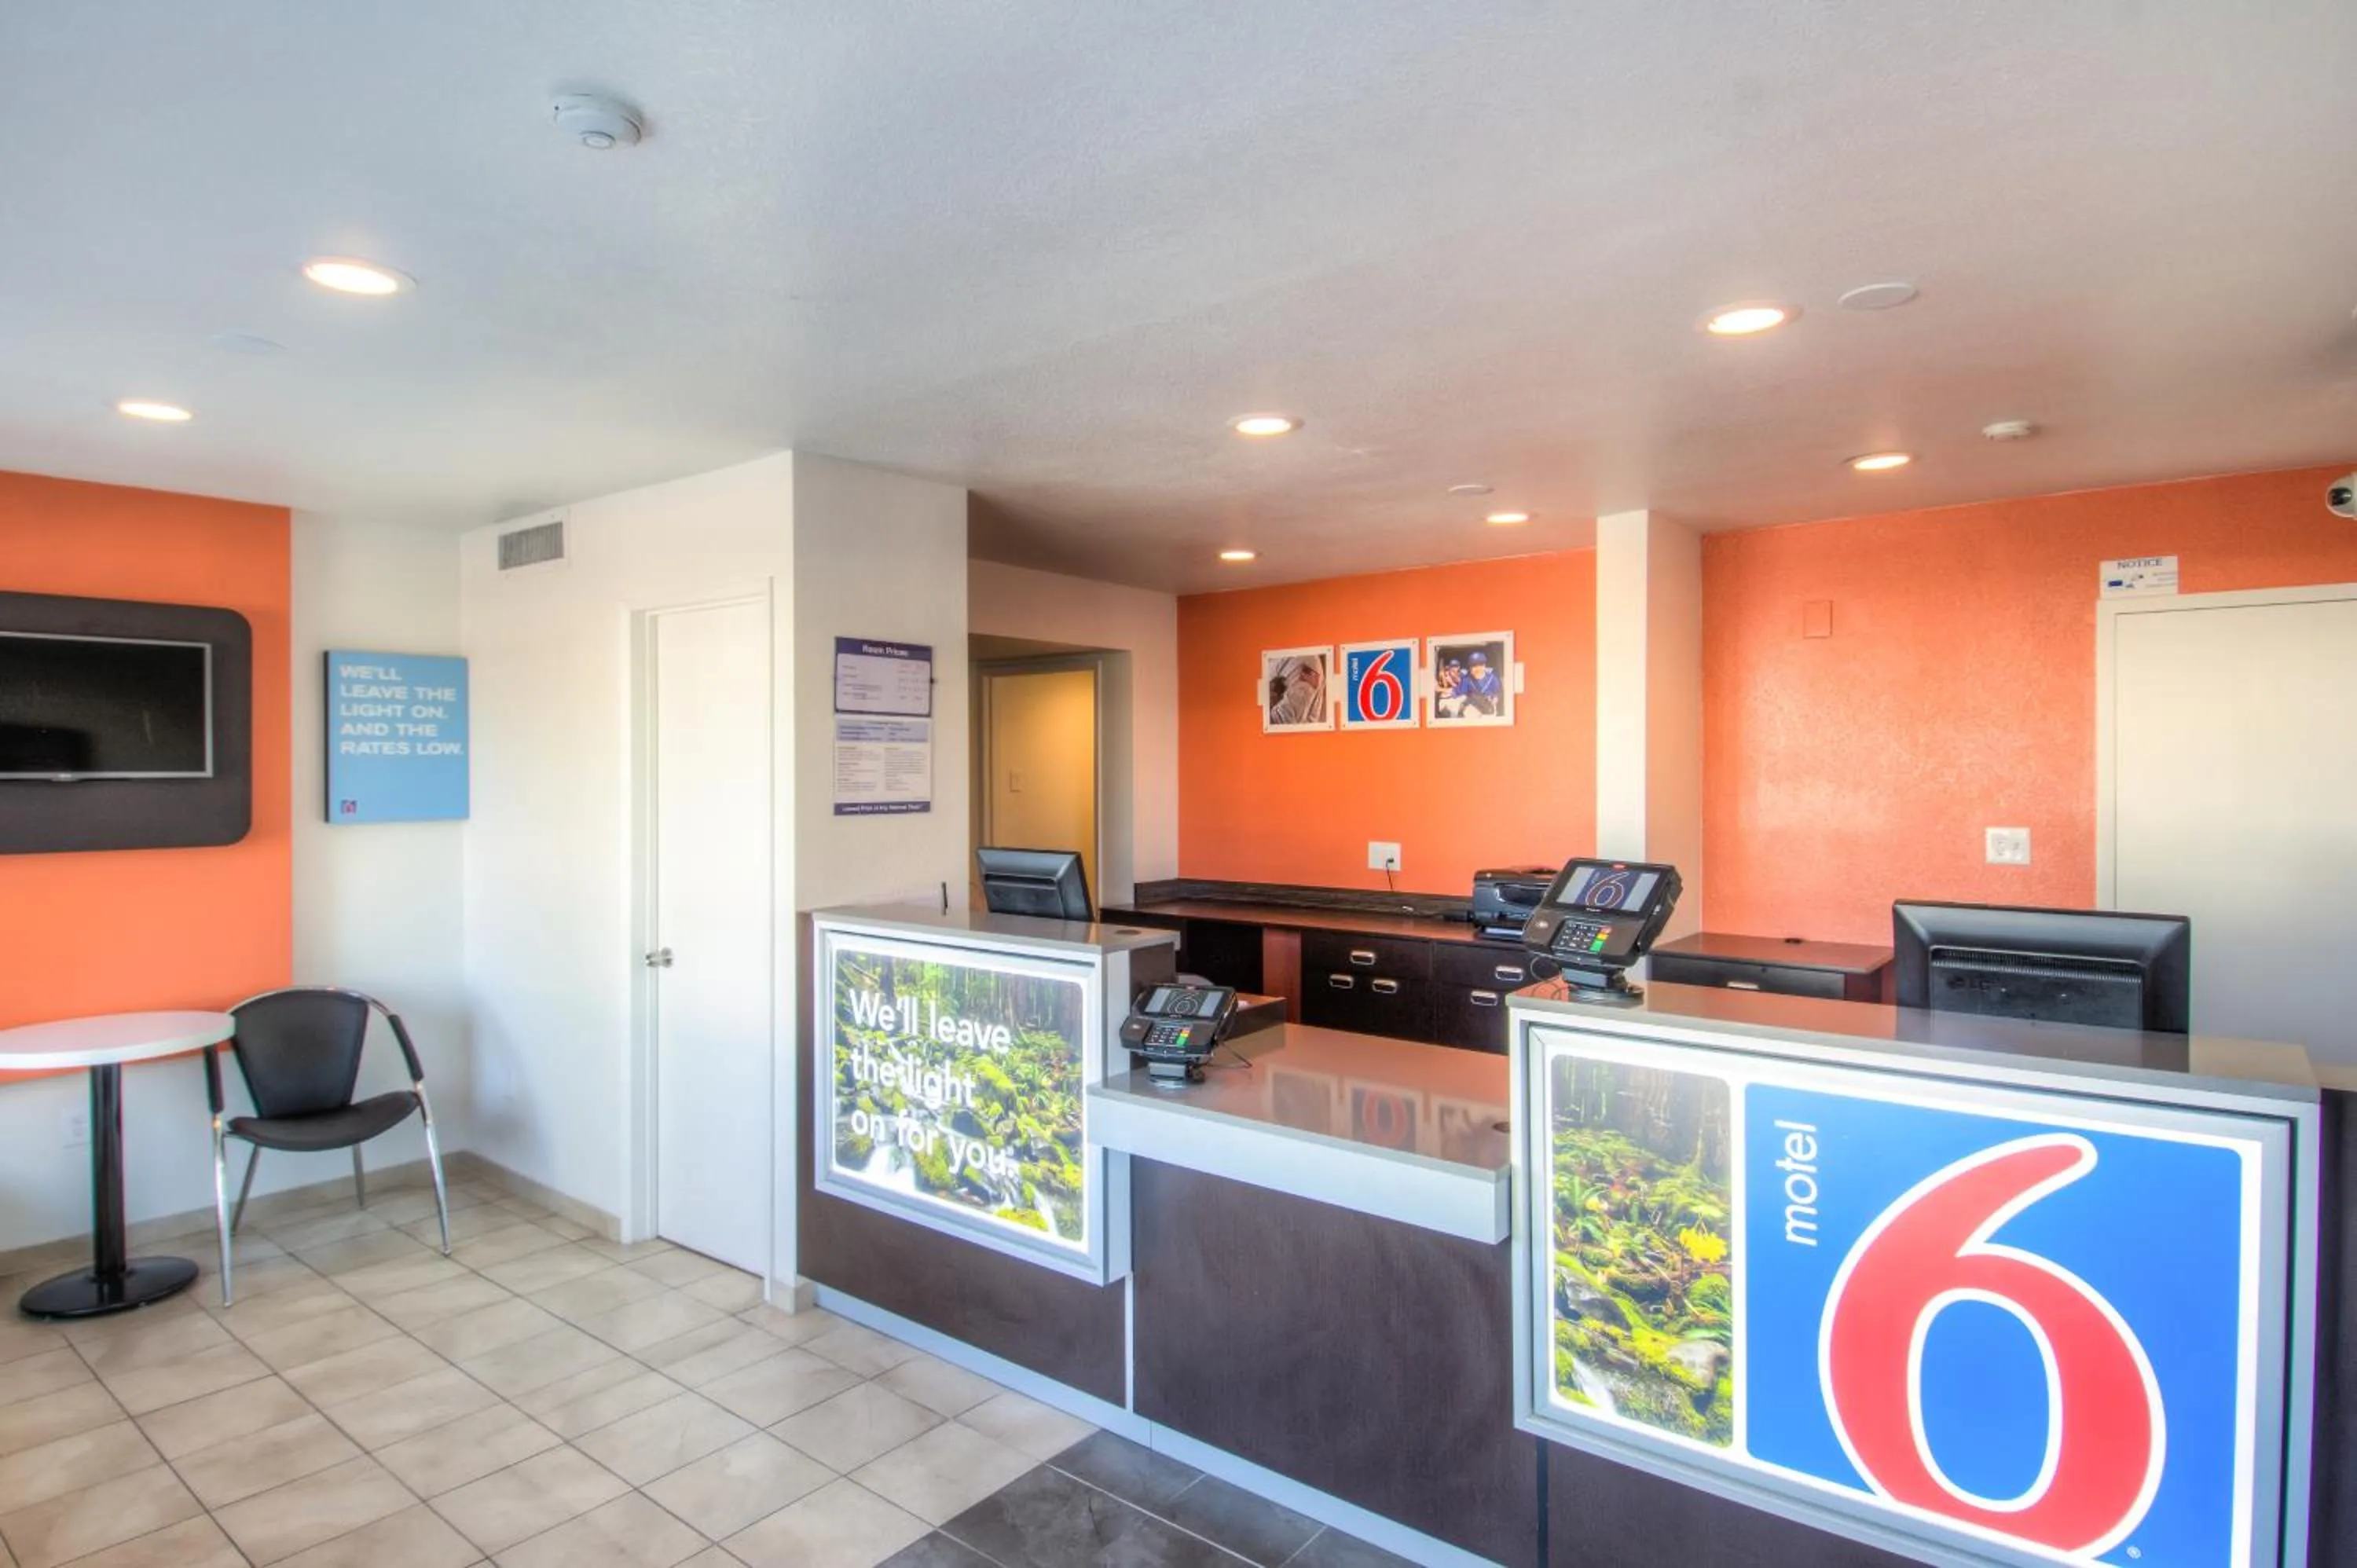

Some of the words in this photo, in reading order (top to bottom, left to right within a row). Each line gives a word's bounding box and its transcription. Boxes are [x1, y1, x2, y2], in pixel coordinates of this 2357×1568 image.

[2117, 558, 2162, 570] NOTICE
[339, 665, 402, 681] WE'LL
[339, 683, 409, 700] LEAVE
[413, 686, 457, 702] THE
[1358, 650, 1404, 722] 6
[339, 703, 405, 718] LIGHT
[411, 705, 449, 719] ON.
[339, 722, 390, 737] AND
[396, 723, 439, 738] THE
[339, 741, 411, 756] RATES
[416, 742, 464, 756] LOW.
[849, 987, 918, 1036] We'll
[929, 1000, 1011, 1054] leave
[851, 1045, 896, 1087] the
[903, 1053, 977, 1109] light
[851, 1108, 885, 1141] on
[897, 1108, 939, 1157] for
[947, 1133, 1017, 1178] you.
[1774, 1119, 1818, 1247] motel
[1818, 1131, 2167, 1562] 6
